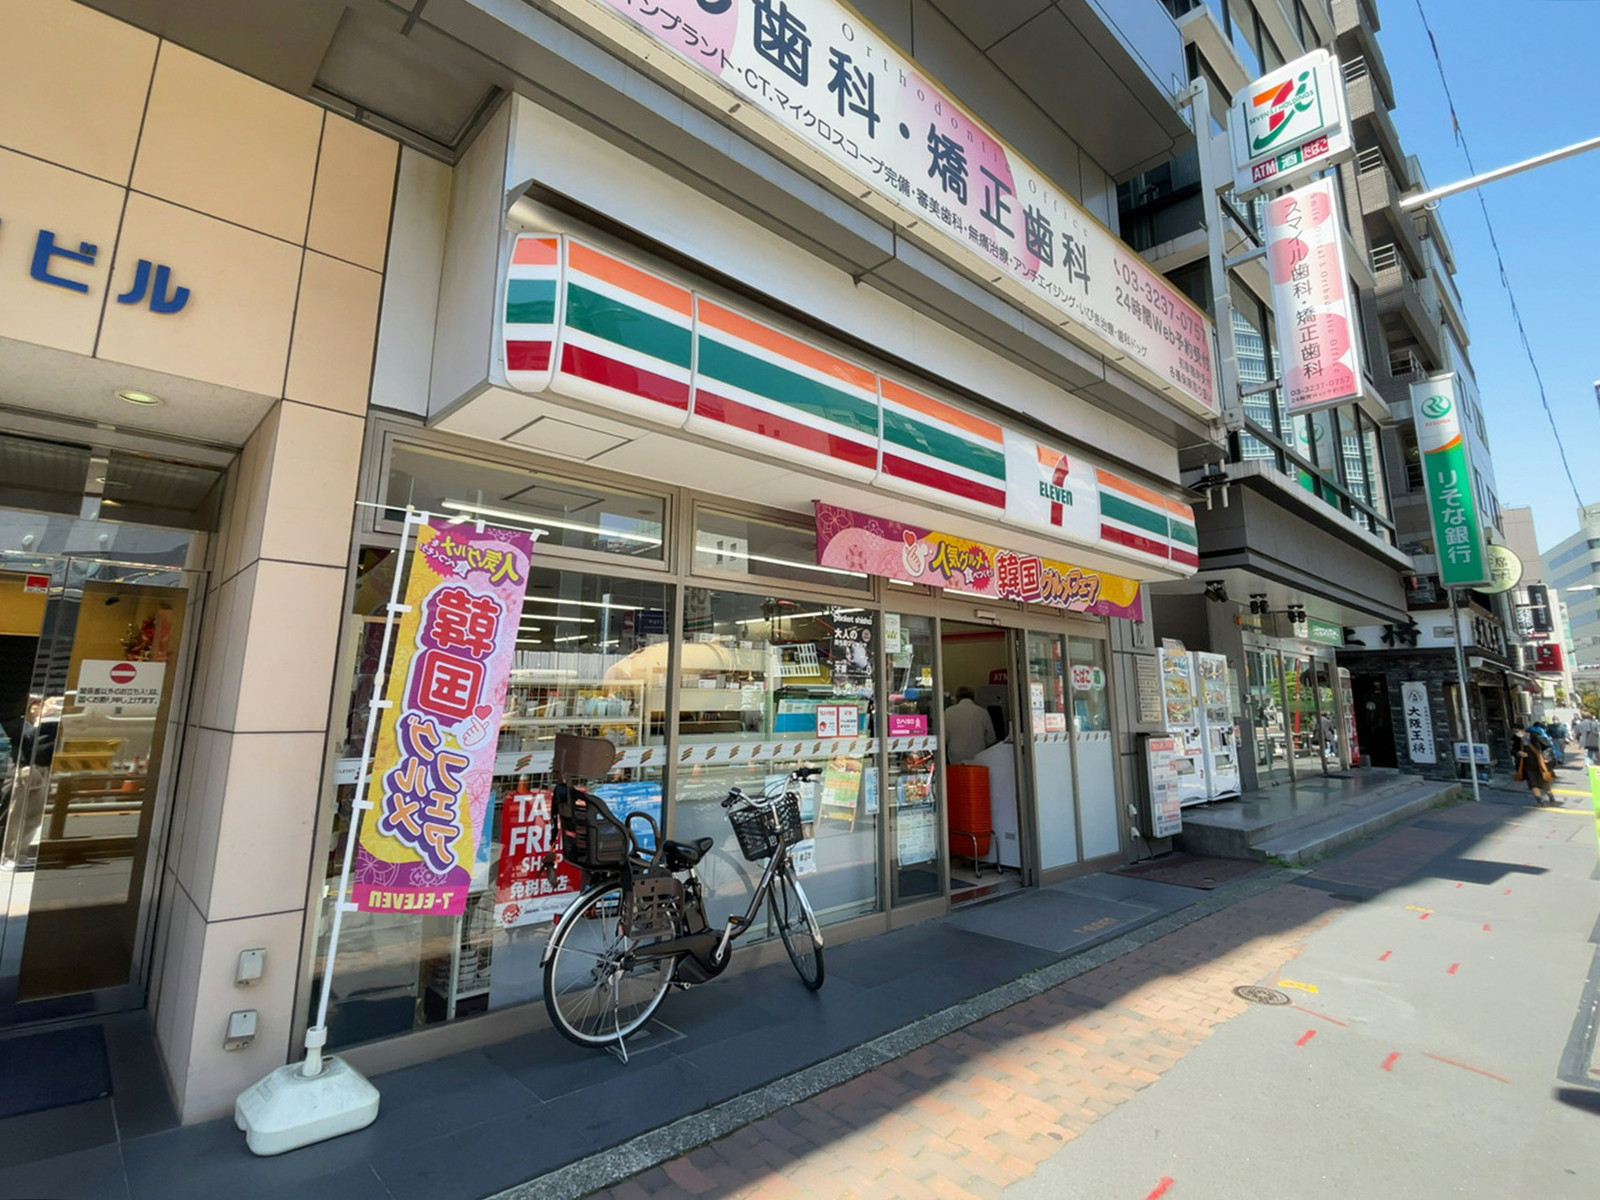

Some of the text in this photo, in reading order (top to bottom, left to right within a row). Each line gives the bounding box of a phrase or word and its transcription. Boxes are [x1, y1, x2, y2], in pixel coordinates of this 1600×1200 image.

[698, 0, 1091, 295] 歯科・矯正歯科
[1253, 160, 1277, 181] ATM
[1303, 138, 1329, 160] たばこ
[1028, 178, 1089, 238] Office
[1122, 264, 1206, 343] 03-3237-0757
[1284, 201, 1325, 380] スマイル歯科・矯正歯科
[1437, 470, 1471, 564] りそな銀行
[834, 628, 858, 640] 大人の
[1407, 706, 1426, 754] 大阪王将
[513, 794, 551, 824] TA
[521, 853, 564, 873] SHP
